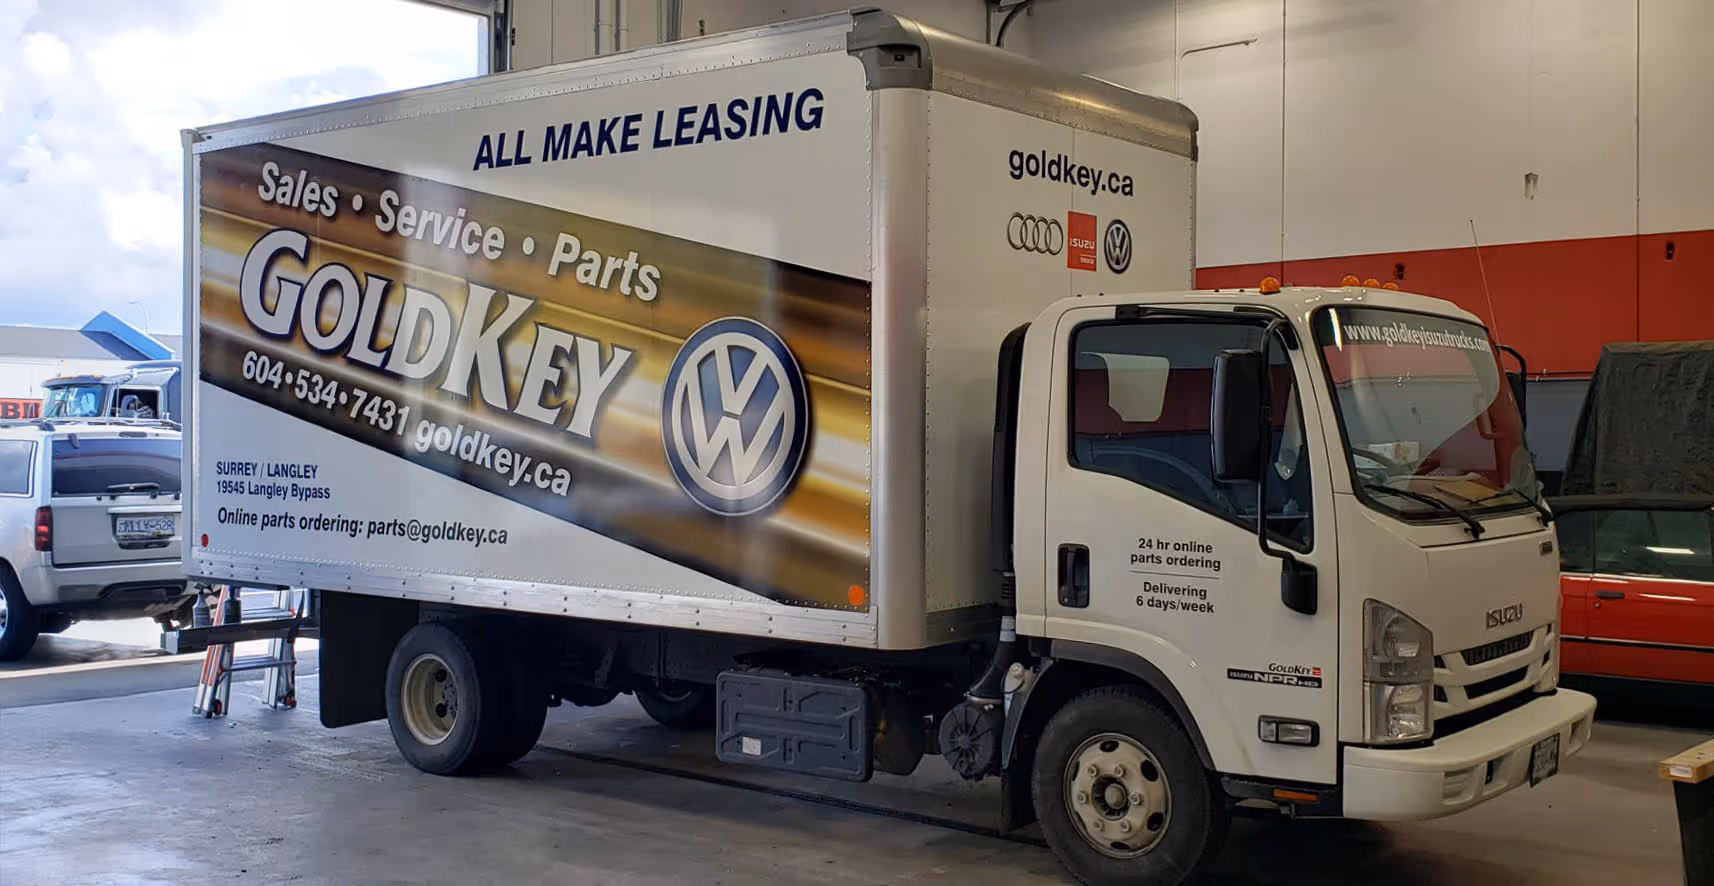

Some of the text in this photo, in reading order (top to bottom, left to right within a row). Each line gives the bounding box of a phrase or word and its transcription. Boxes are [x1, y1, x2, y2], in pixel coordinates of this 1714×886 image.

[472, 88, 824, 170] ALL MAKE LEASING
[1008, 150, 1134, 197] goldkey.ca
[258, 161, 339, 217] Sales
[375, 189, 505, 261] Service
[547, 232, 661, 302] Parts
[1069, 238, 1095, 249] ISUZU
[414, 419, 572, 496] goldkey.ca
[216, 461, 257, 476] SURREY
[267, 463, 318, 480] LANGLEY
[216, 480, 331, 502] 19545 Langley Bypass
[217, 507, 508, 548] Online parts ordering: parts@goldkey.ca
[1138, 538, 1213, 553] 24 hr online
[1130, 553, 1221, 572] parts ordering
[1143, 582, 1207, 600] Delivering
[1136, 596, 1215, 614] 6 days/week
[1486, 602, 1523, 629] ISUZU
[1253, 672, 1298, 685] NPR
